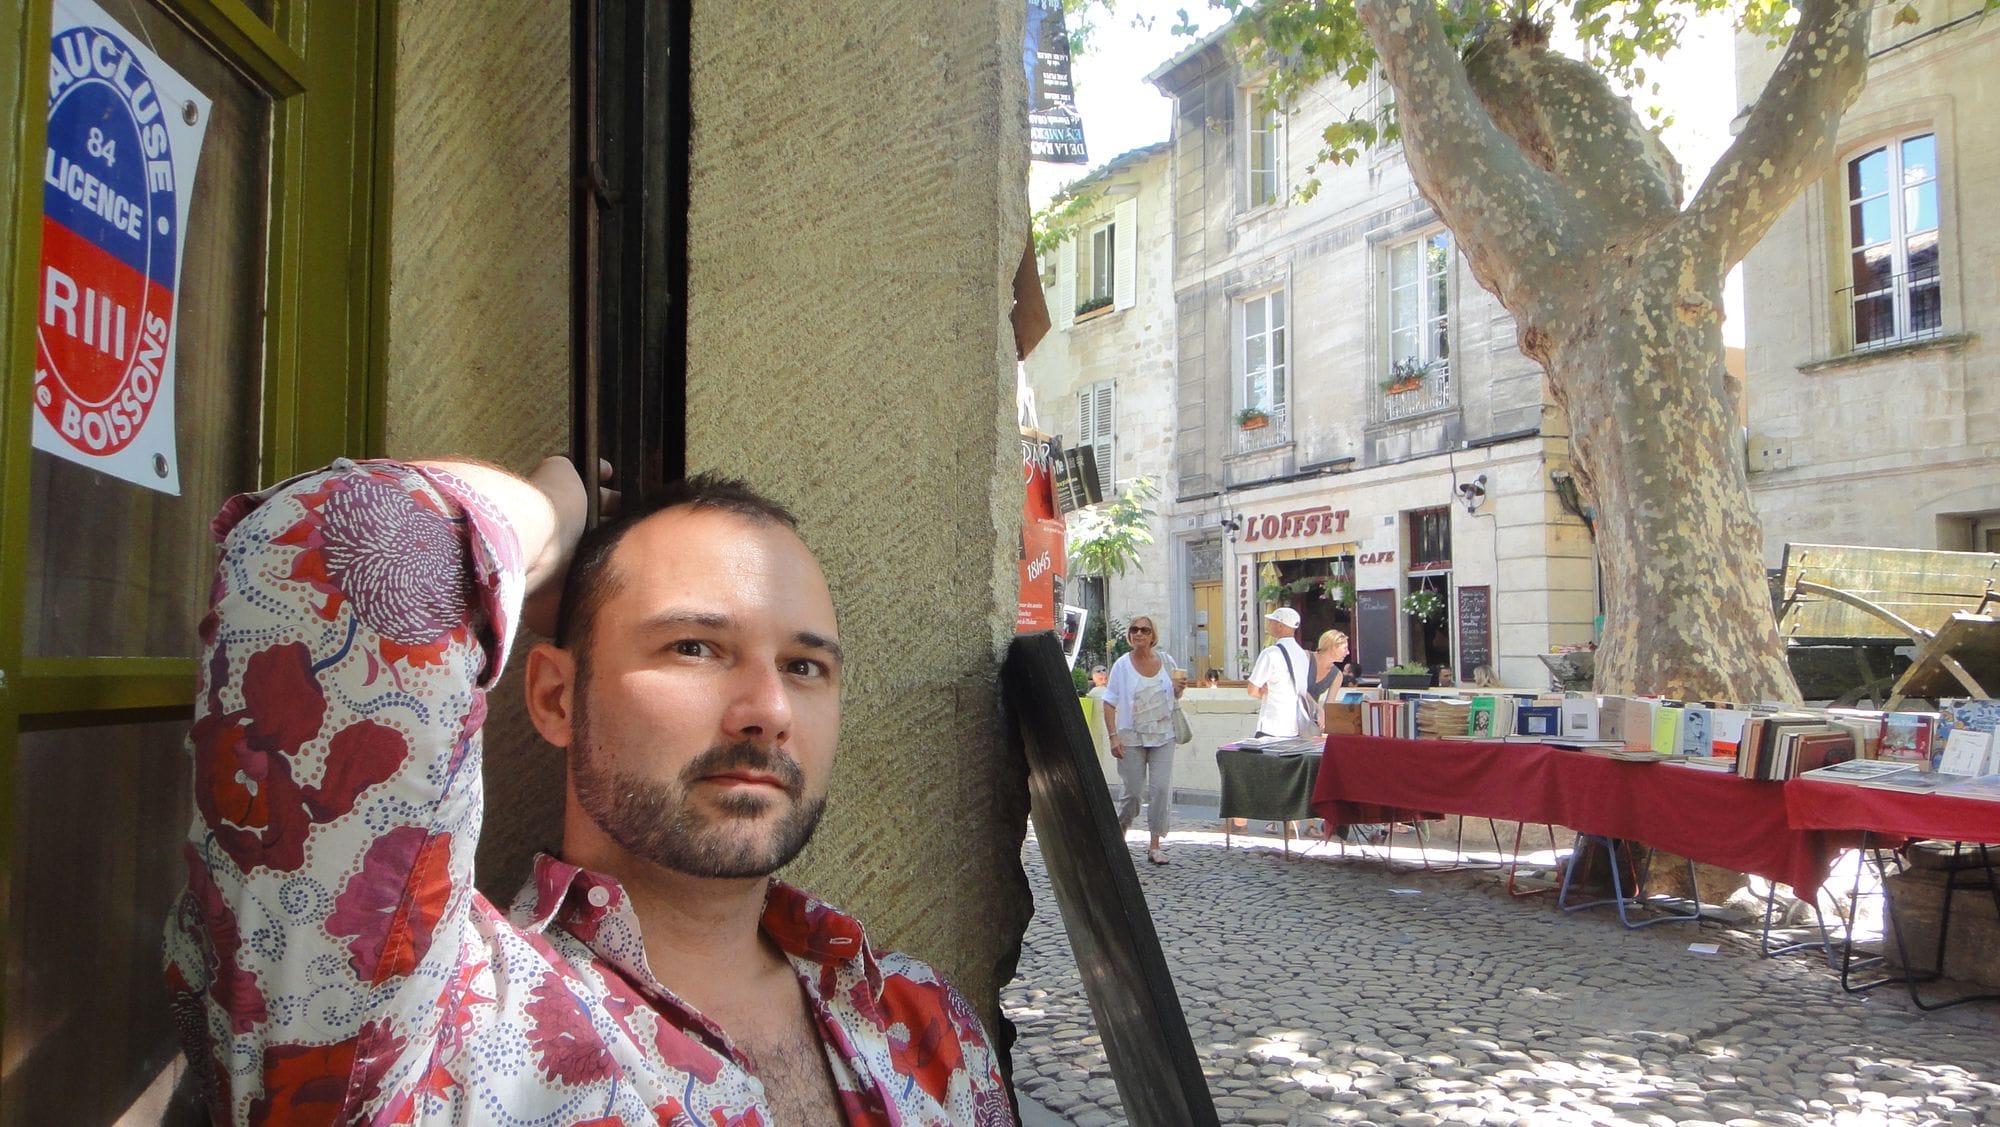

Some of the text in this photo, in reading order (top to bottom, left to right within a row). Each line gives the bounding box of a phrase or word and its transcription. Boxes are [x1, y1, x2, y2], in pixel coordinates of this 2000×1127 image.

[49, 31, 173, 194] AUCLUSE
[87, 126, 117, 168] 84
[1055, 143, 1069, 156] LA
[1070, 143, 1085, 156] DE
[44, 146, 143, 241] LICENCE
[61, 310, 167, 450] BOISSONS
[1244, 505, 1350, 543] L'OFFSET
